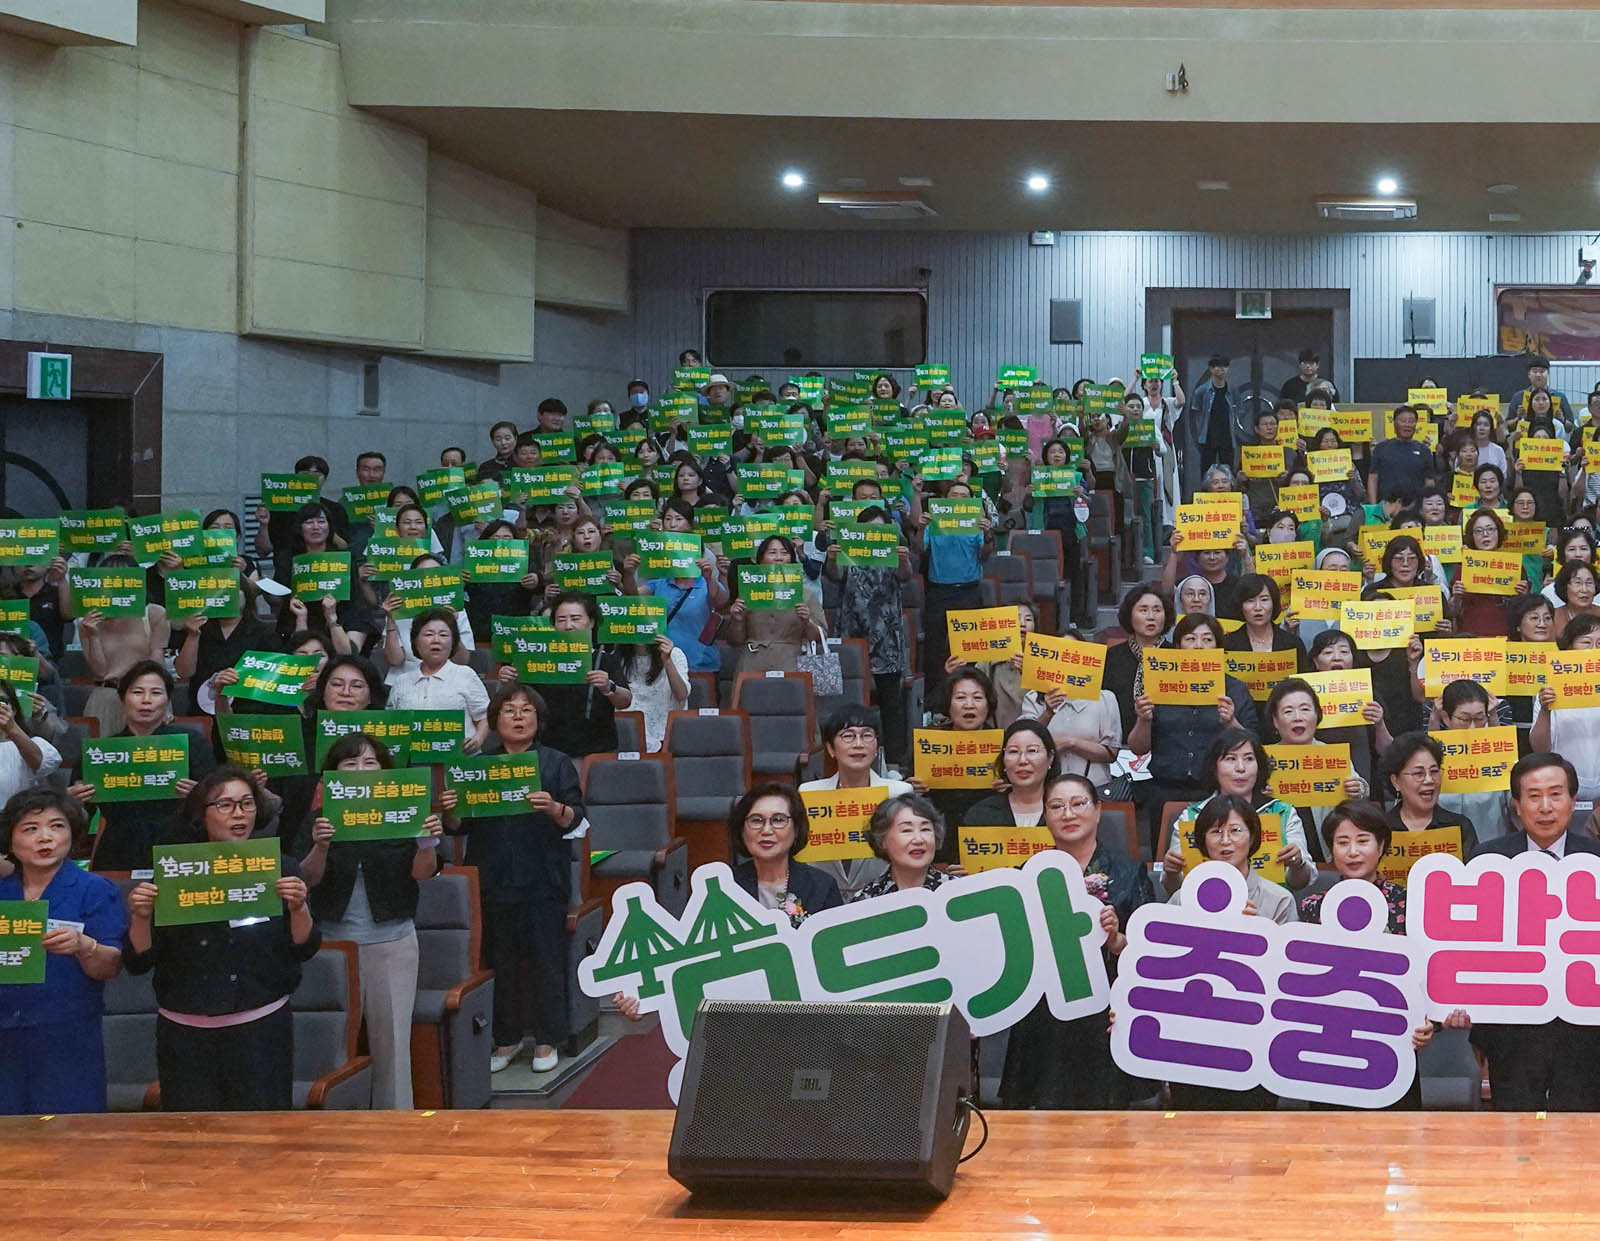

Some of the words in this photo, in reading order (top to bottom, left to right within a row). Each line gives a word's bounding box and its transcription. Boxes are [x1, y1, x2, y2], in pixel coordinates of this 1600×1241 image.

[1179, 513, 1204, 523] 모두가
[1205, 510, 1220, 522] 존중
[1220, 512, 1235, 521] 받는
[1188, 528, 1211, 540] 행복한
[70, 577, 102, 588] 모두가
[103, 575, 122, 587] 존중
[123, 578, 141, 587] 받는
[393, 579, 422, 590] 모두가
[423, 574, 441, 587] 존중
[441, 575, 459, 585] 받는
[81, 594, 111, 607] 행복한
[404, 594, 432, 608] 행복한
[950, 621, 978, 632] 모두가
[979, 616, 997, 630] 존중
[997, 618, 1015, 629] 받는
[516, 641, 547, 652] 모두가
[548, 639, 567, 652] 존중
[568, 642, 588, 652] 받는
[961, 637, 988, 651] 행복한
[1028, 644, 1060, 661] 모두가
[1061, 648, 1080, 664] 존중
[1080, 655, 1099, 667] 받는
[526, 659, 556, 672] 행복한
[1147, 659, 1179, 671] 모두가
[1180, 658, 1200, 672] 존중
[1200, 661, 1220, 672] 받는
[1551, 662, 1583, 674] 모두가
[1035, 666, 1065, 684] 행복한
[1158, 679, 1188, 693] 행복한
[1563, 681, 1593, 696] 행복한
[89, 751, 130, 764] 모두가
[132, 746, 157, 762] 존중
[158, 749, 183, 761] 받는
[102, 771, 142, 788] 행복한
[450, 769, 487, 782] 모두가
[488, 764, 511, 779] 존중
[511, 766, 534, 777] 받는
[329, 784, 371, 799] 모두가
[373, 780, 399, 797] 존중
[400, 783, 425, 796] 받는
[465, 788, 500, 804] 행복한
[342, 808, 383, 826] 행복한
[161, 860, 211, 877] 모두가
[213, 853, 243, 874] 존중
[245, 856, 274, 871] 받는
[178, 885, 225, 907] 행복한
[1127, 877, 1411, 1091] 존중
